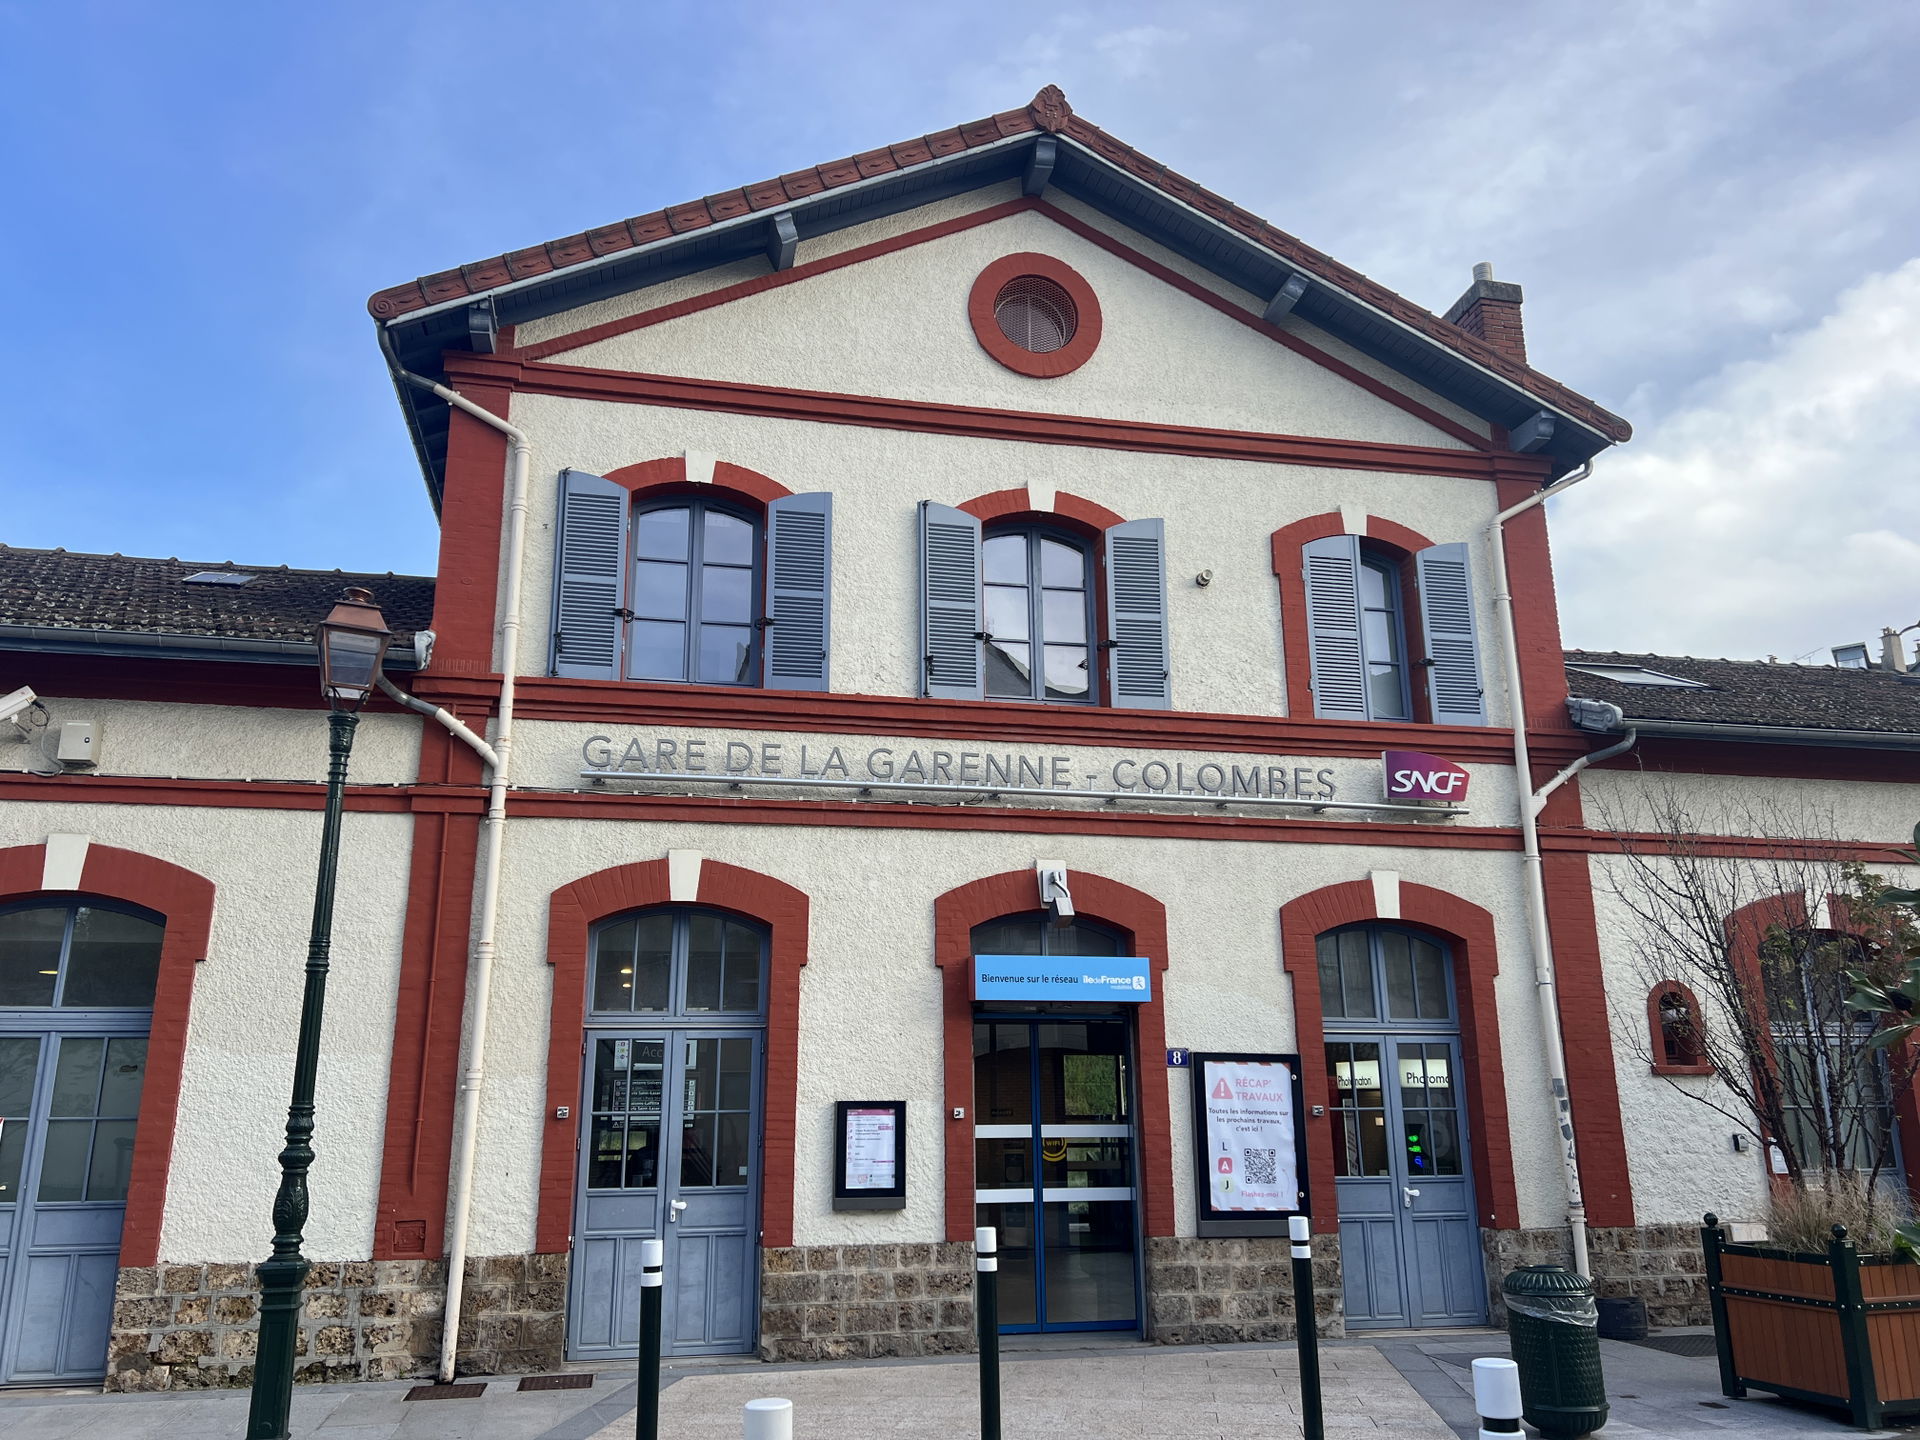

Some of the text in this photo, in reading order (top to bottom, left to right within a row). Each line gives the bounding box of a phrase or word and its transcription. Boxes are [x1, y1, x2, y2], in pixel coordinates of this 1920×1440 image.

[582, 735, 706, 771] GARE
[725, 741, 782, 775] DE
[800, 745, 850, 777] LA
[866, 747, 1071, 786] GARENNE
[1112, 759, 1337, 798] COLOMBES
[1391, 768, 1466, 795] SNCF
[981, 973, 1025, 983] Bienvenue
[1041, 974, 1049, 984] le
[1051, 974, 1079, 984] réseau
[1172, 1050, 1182, 1065] 8
[1235, 1091, 1283, 1102] TRAVAUX
[1240, 1108, 1278, 1116] informations
[1222, 1141, 1228, 1151] L
[1221, 1160, 1230, 1171] A
[1224, 1180, 1229, 1190] J
